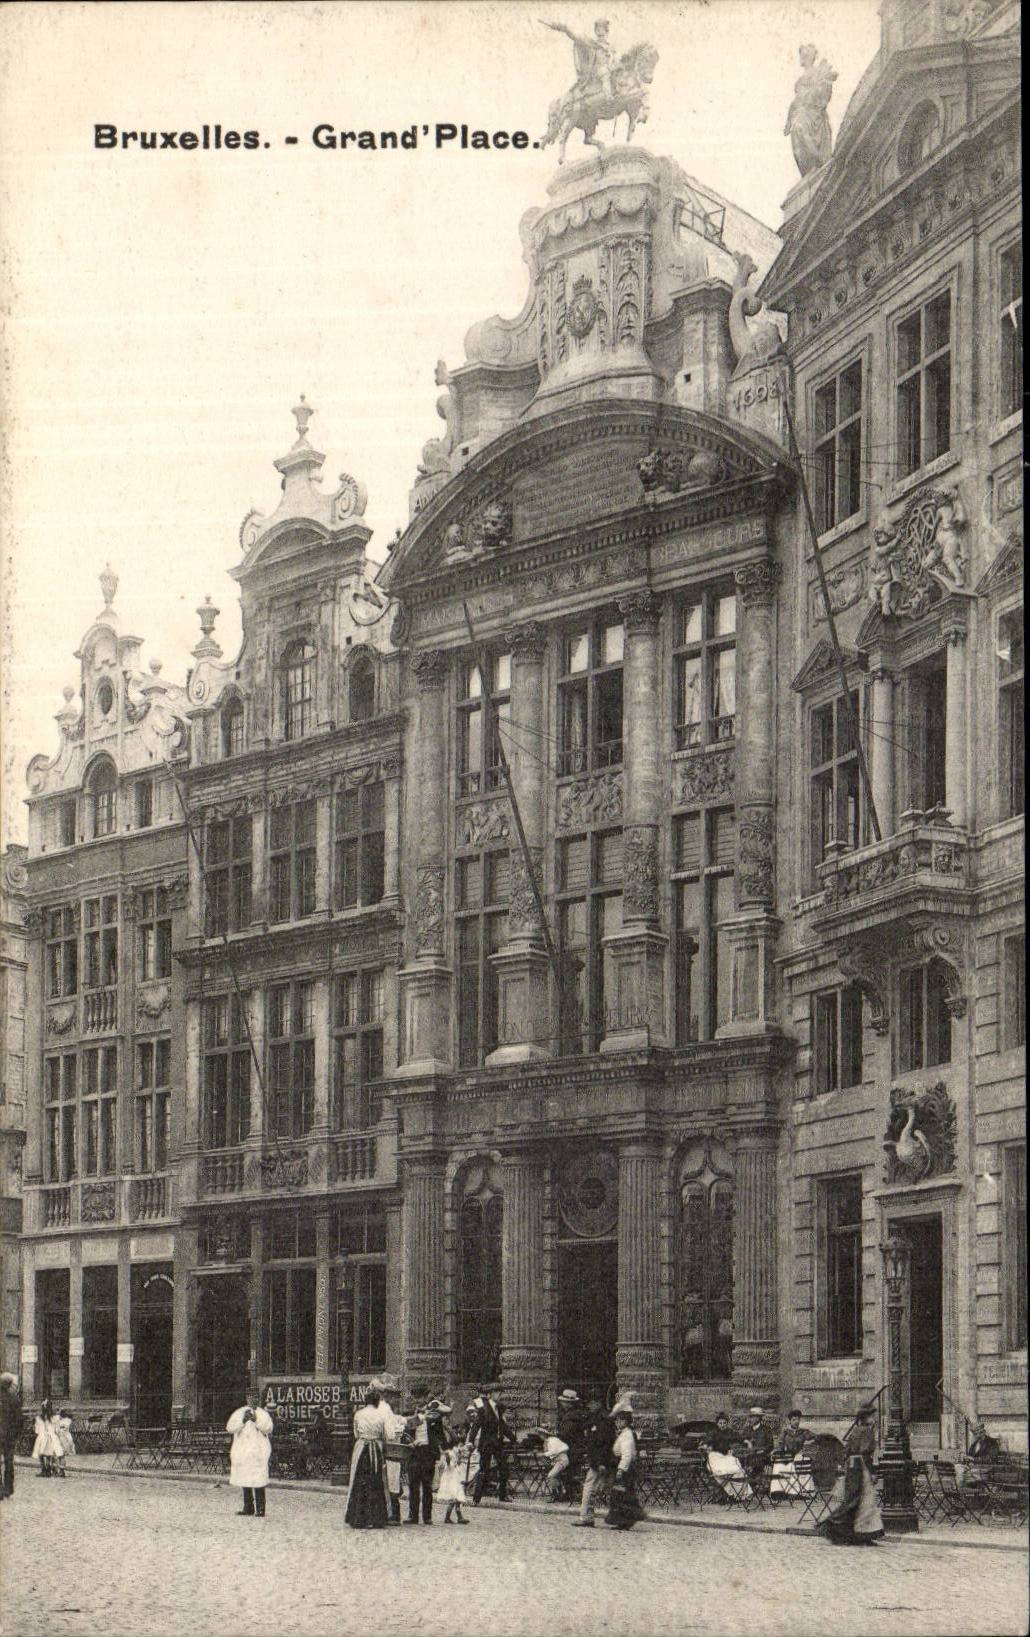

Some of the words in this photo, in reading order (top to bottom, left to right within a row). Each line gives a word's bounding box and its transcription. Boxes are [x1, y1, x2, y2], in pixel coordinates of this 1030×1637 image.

[265, 1386, 274, 1402] A
[277, 1386, 294, 1403] LA
[296, 1385, 330, 1403] ROSE
